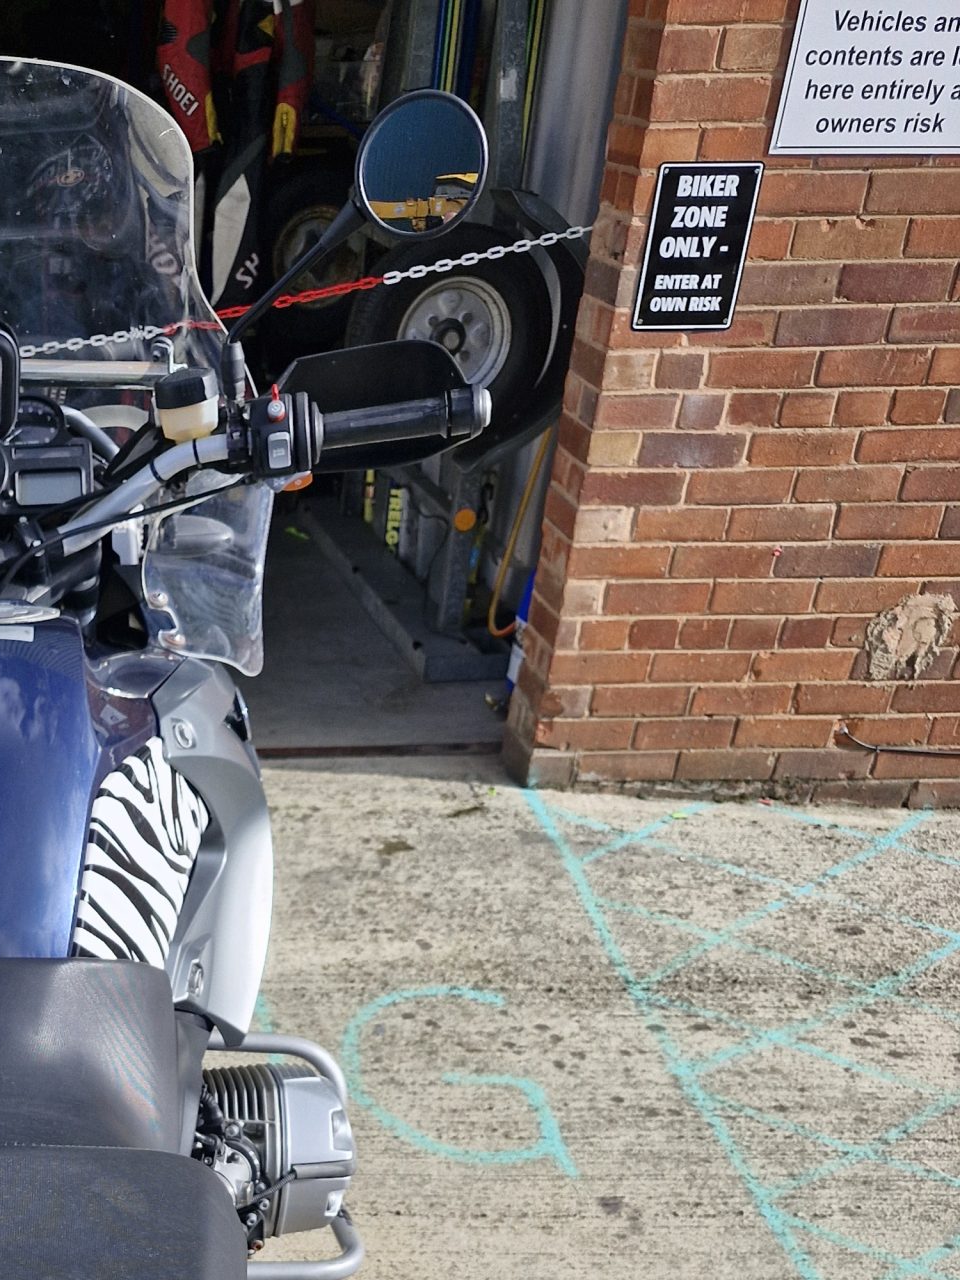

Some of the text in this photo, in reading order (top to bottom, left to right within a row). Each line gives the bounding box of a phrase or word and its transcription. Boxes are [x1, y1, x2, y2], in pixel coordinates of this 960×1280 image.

[834, 9, 928, 32] Vehicles
[804, 45, 960, 67] contents are l
[804, 78, 855, 100] here
[860, 78, 946, 106] entirely
[815, 112, 946, 134] owners risk
[676, 174, 740, 198] BIKER
[670, 205, 729, 229] ZONE
[658, 235, 718, 259] ONLY
[653, 274, 723, 290] ENTER AT
[649, 296, 723, 313] OWN RISK
